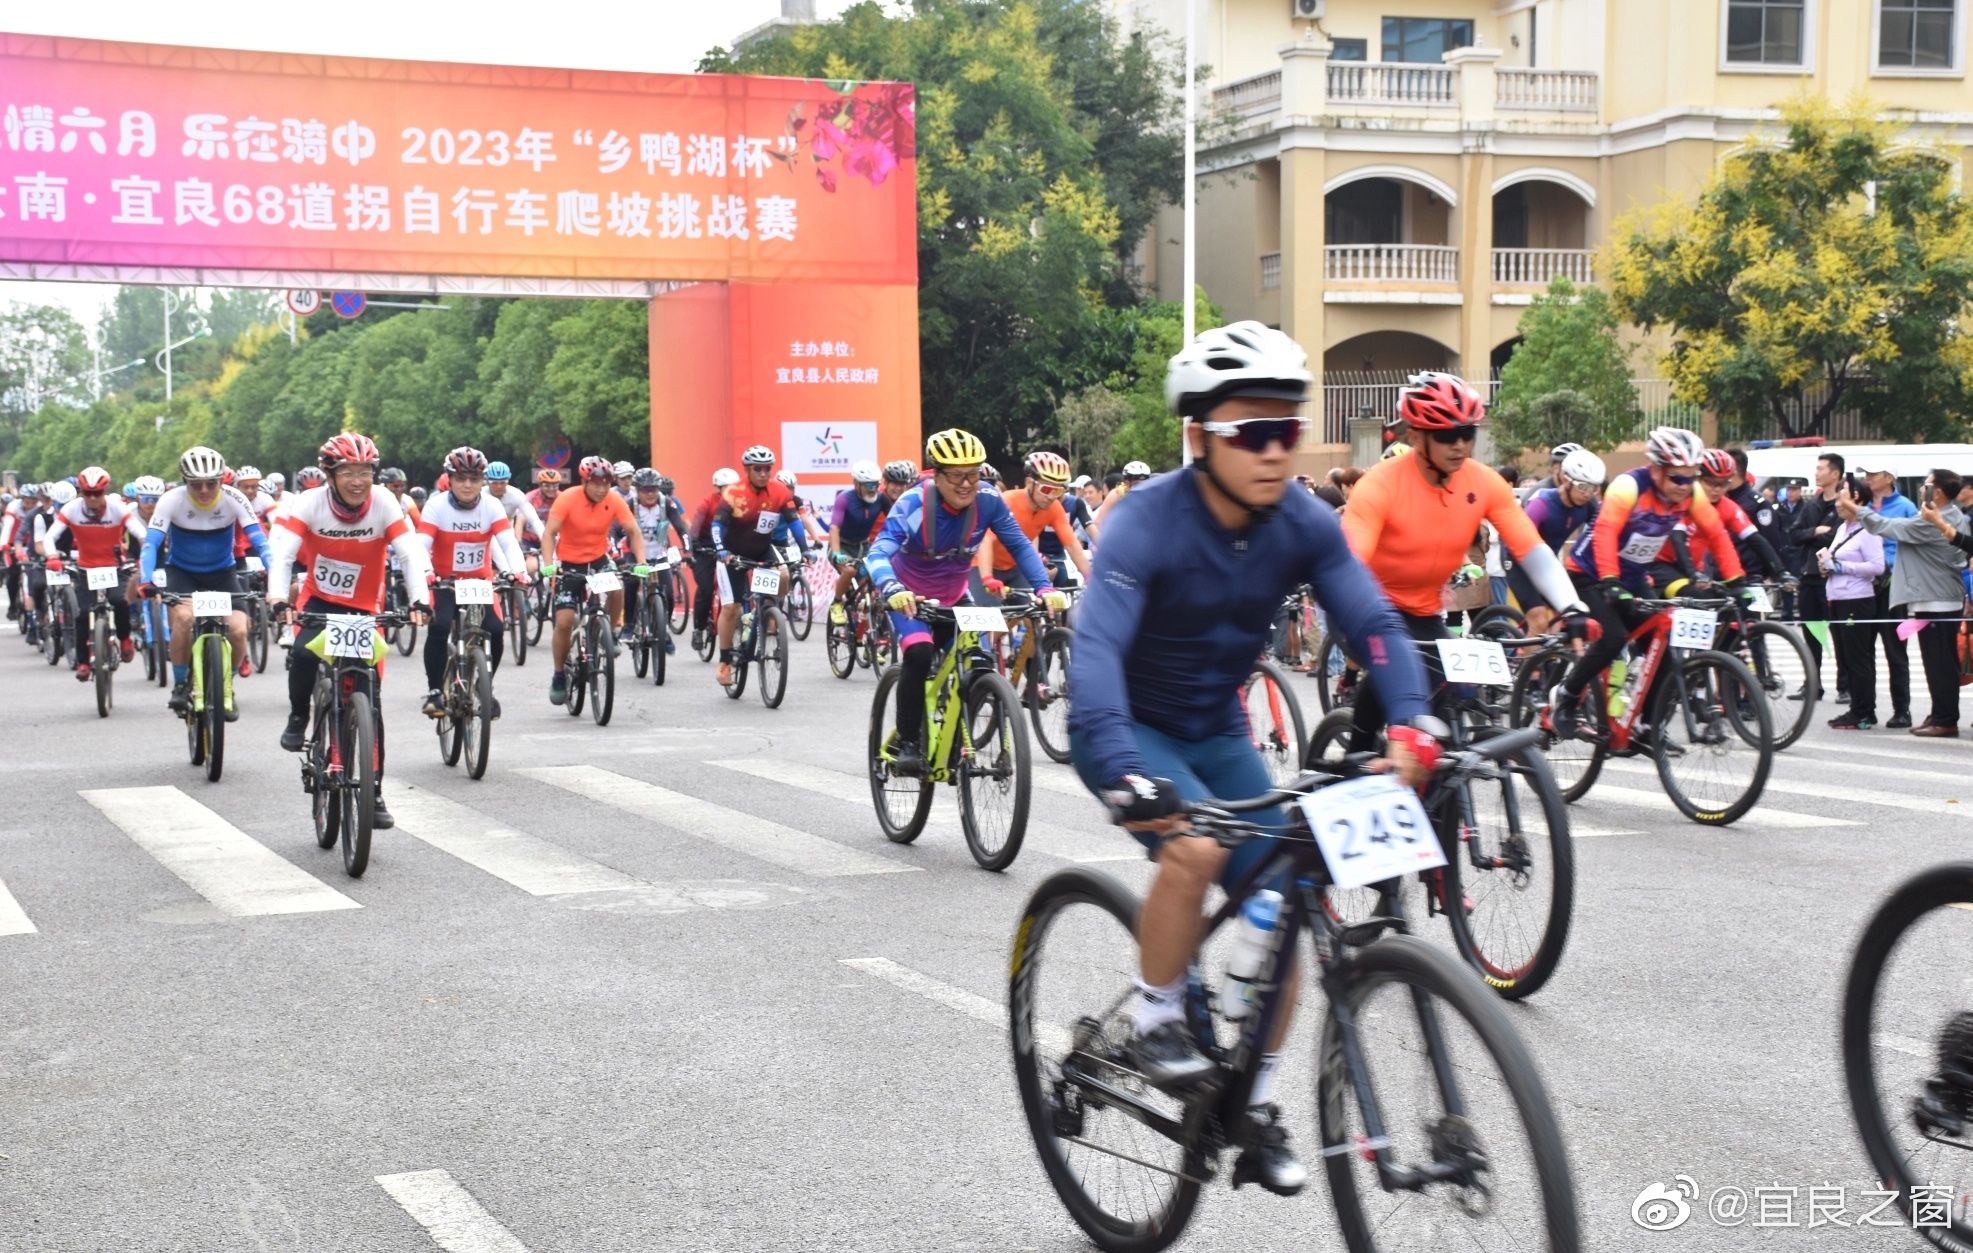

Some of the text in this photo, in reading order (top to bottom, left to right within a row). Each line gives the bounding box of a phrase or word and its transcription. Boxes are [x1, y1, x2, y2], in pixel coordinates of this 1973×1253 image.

[0, 104, 157, 157] 情六月
[182, 113, 377, 167] 乐在骑中
[0, 171, 798, 242] 南·宜良68道拐自行车爬坡挑战赛
[296, 290, 312, 306] 40
[790, 341, 856, 358] 主办单位：
[776, 367, 880, 384] 宜良县人民政府
[456, 549, 484, 565] 318
[1626, 544, 1661, 557] 369
[91, 573, 114, 584] 341
[316, 565, 356, 588] 308
[754, 575, 777, 589] 366
[459, 587, 490, 598] 318
[197, 599, 228, 610] 203
[329, 627, 371, 648] 308
[1677, 621, 1711, 640] 369
[1449, 652, 1503, 674] 276
[1329, 804, 1423, 861] 249
